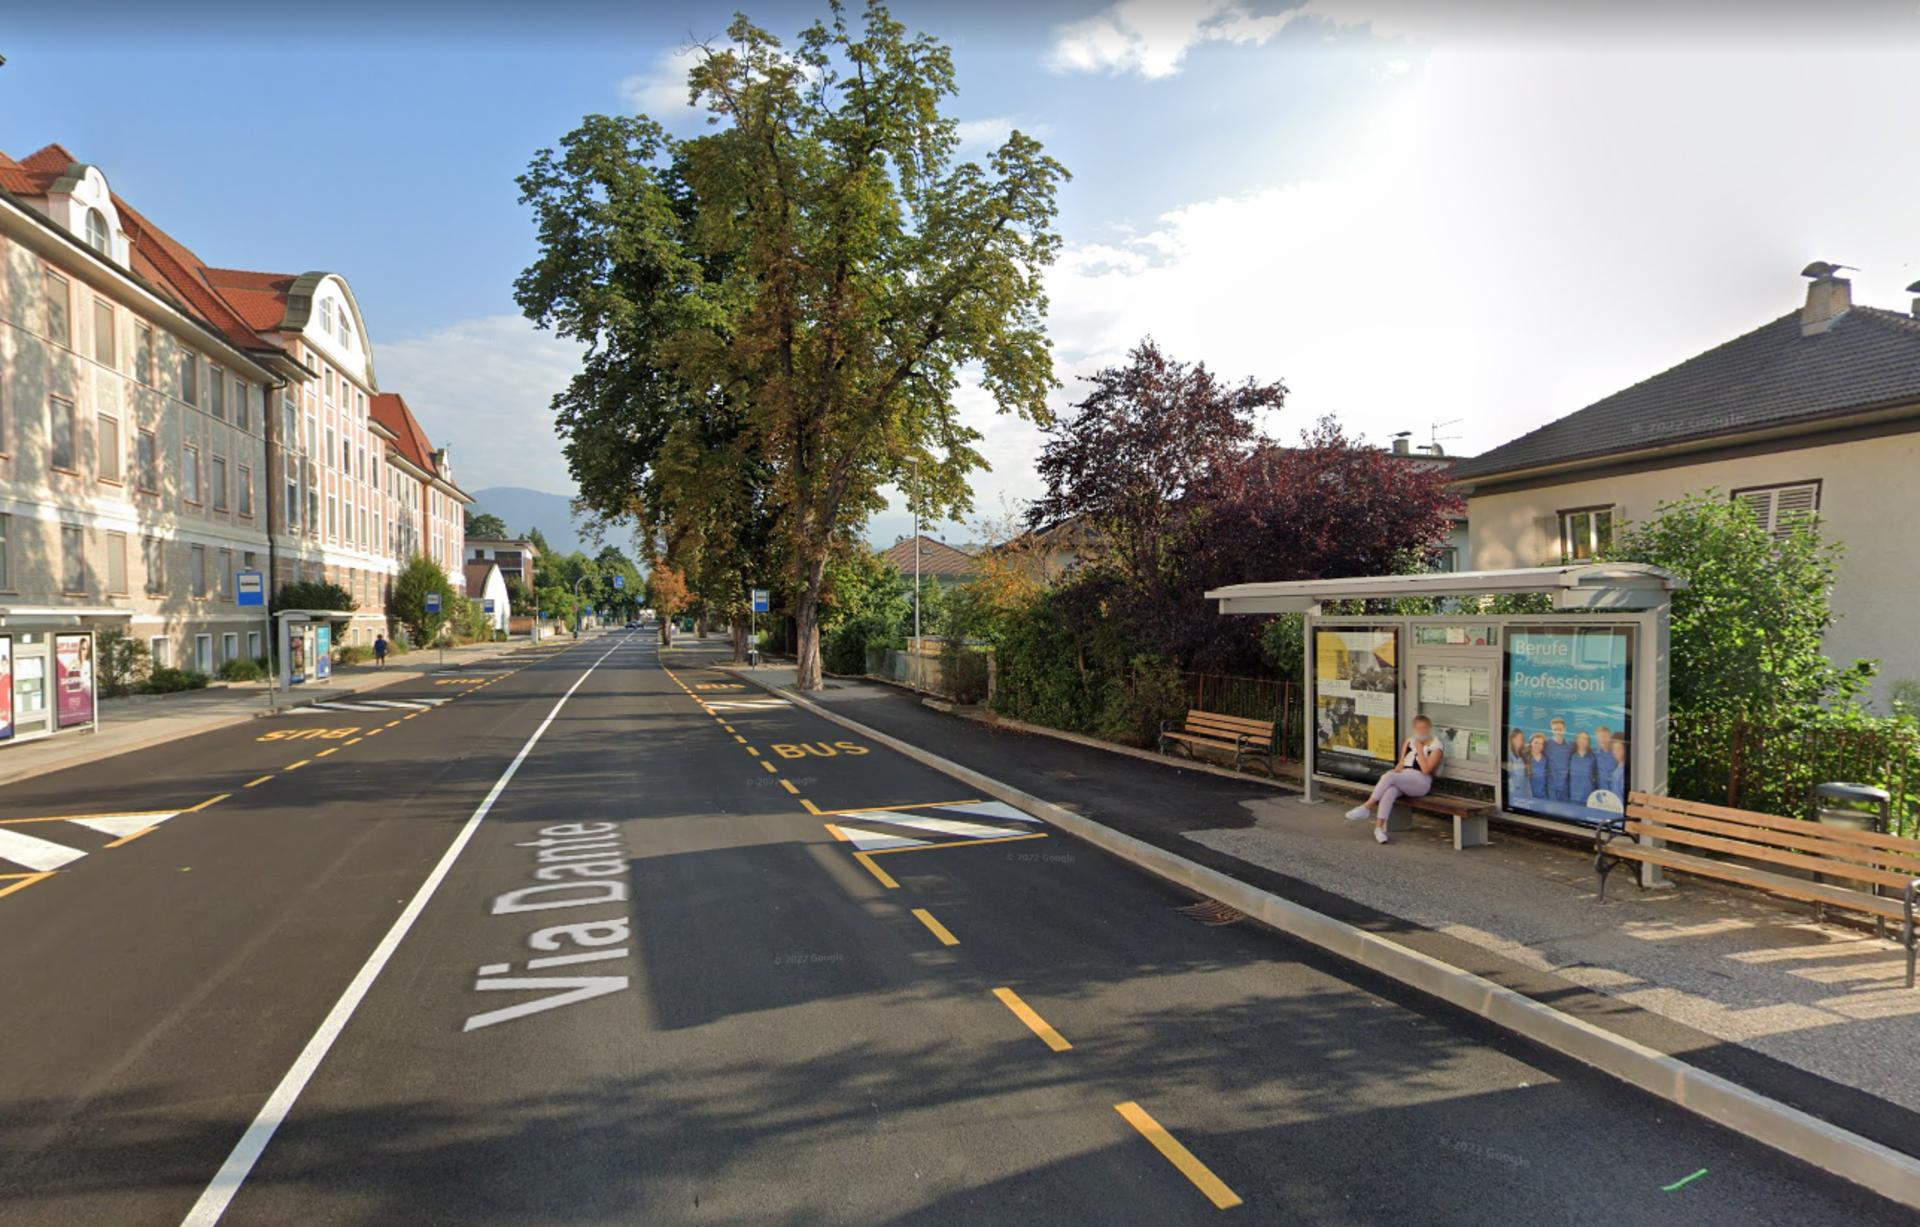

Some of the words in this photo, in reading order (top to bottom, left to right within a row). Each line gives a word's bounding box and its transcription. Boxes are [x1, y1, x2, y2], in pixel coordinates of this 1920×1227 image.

[1515, 639, 1569, 656] Berufe
[1514, 671, 1606, 693] Professioni
[256, 726, 363, 742] BUS
[770, 740, 871, 759] BUS
[491, 821, 631, 916] Dante
[462, 916, 629, 1033] Via
